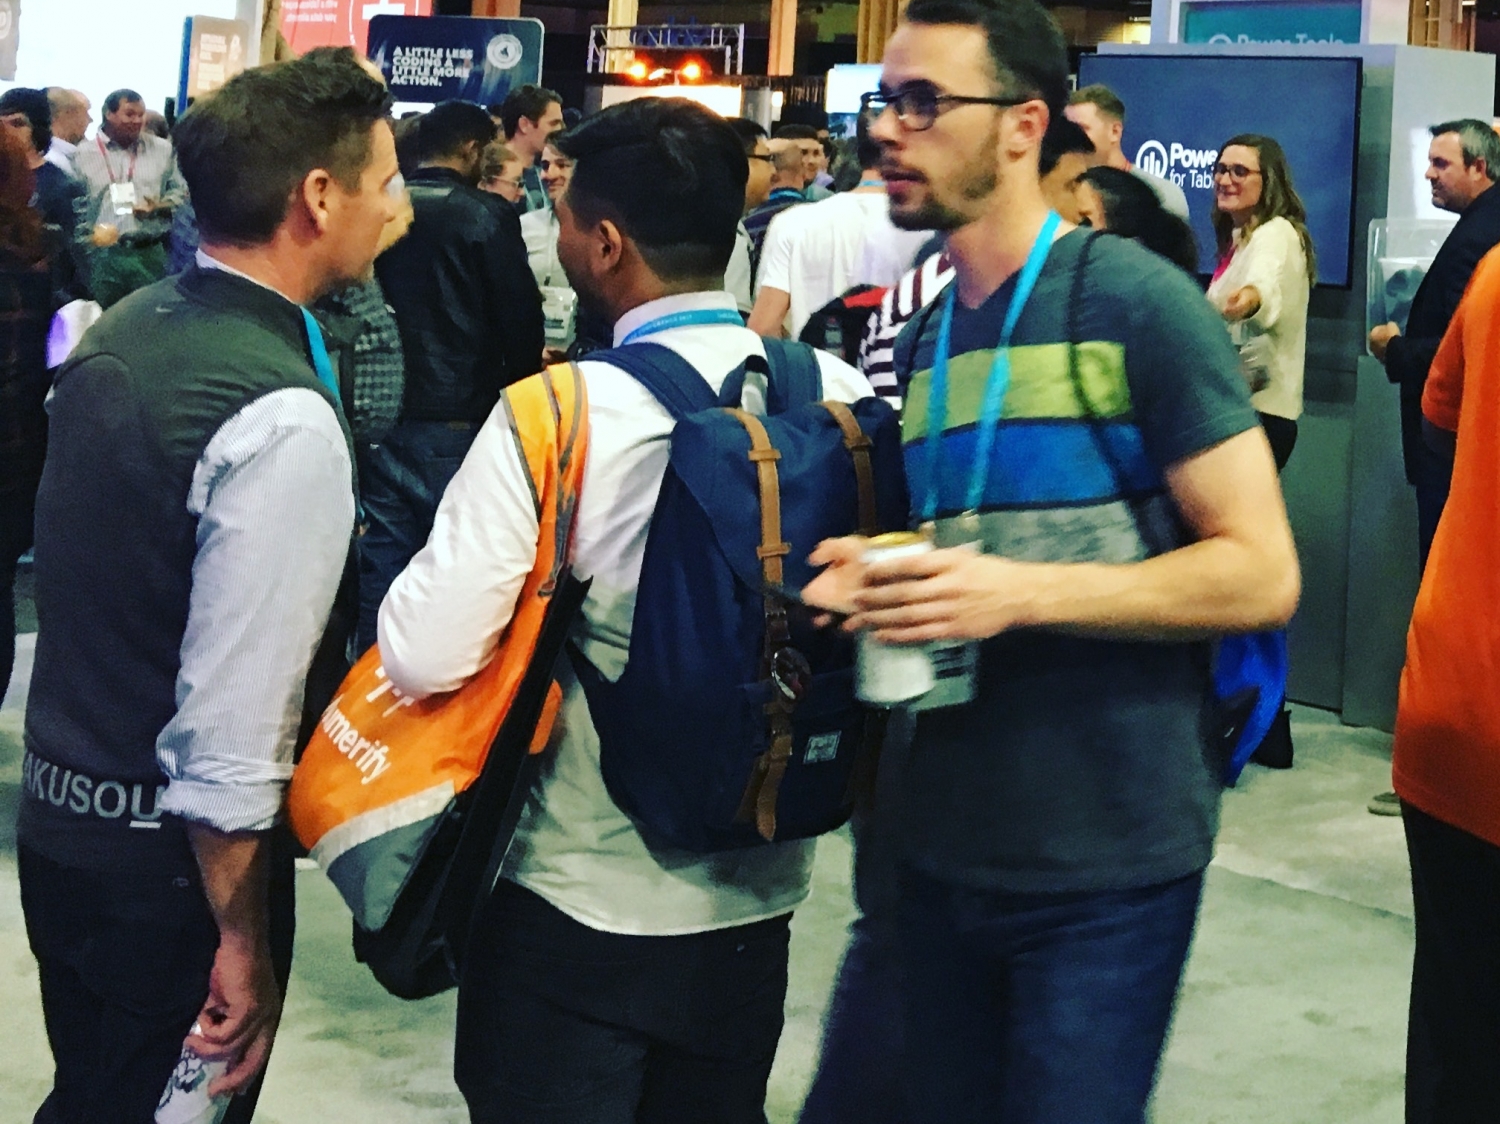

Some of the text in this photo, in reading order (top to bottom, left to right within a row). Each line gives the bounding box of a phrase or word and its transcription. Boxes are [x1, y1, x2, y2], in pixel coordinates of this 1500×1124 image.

[393, 45, 474, 60] A LITTLE LESS
[392, 56, 454, 68] CODING A
[391, 65, 470, 78] LITTLE MORE
[390, 76, 443, 87] ACTION.
